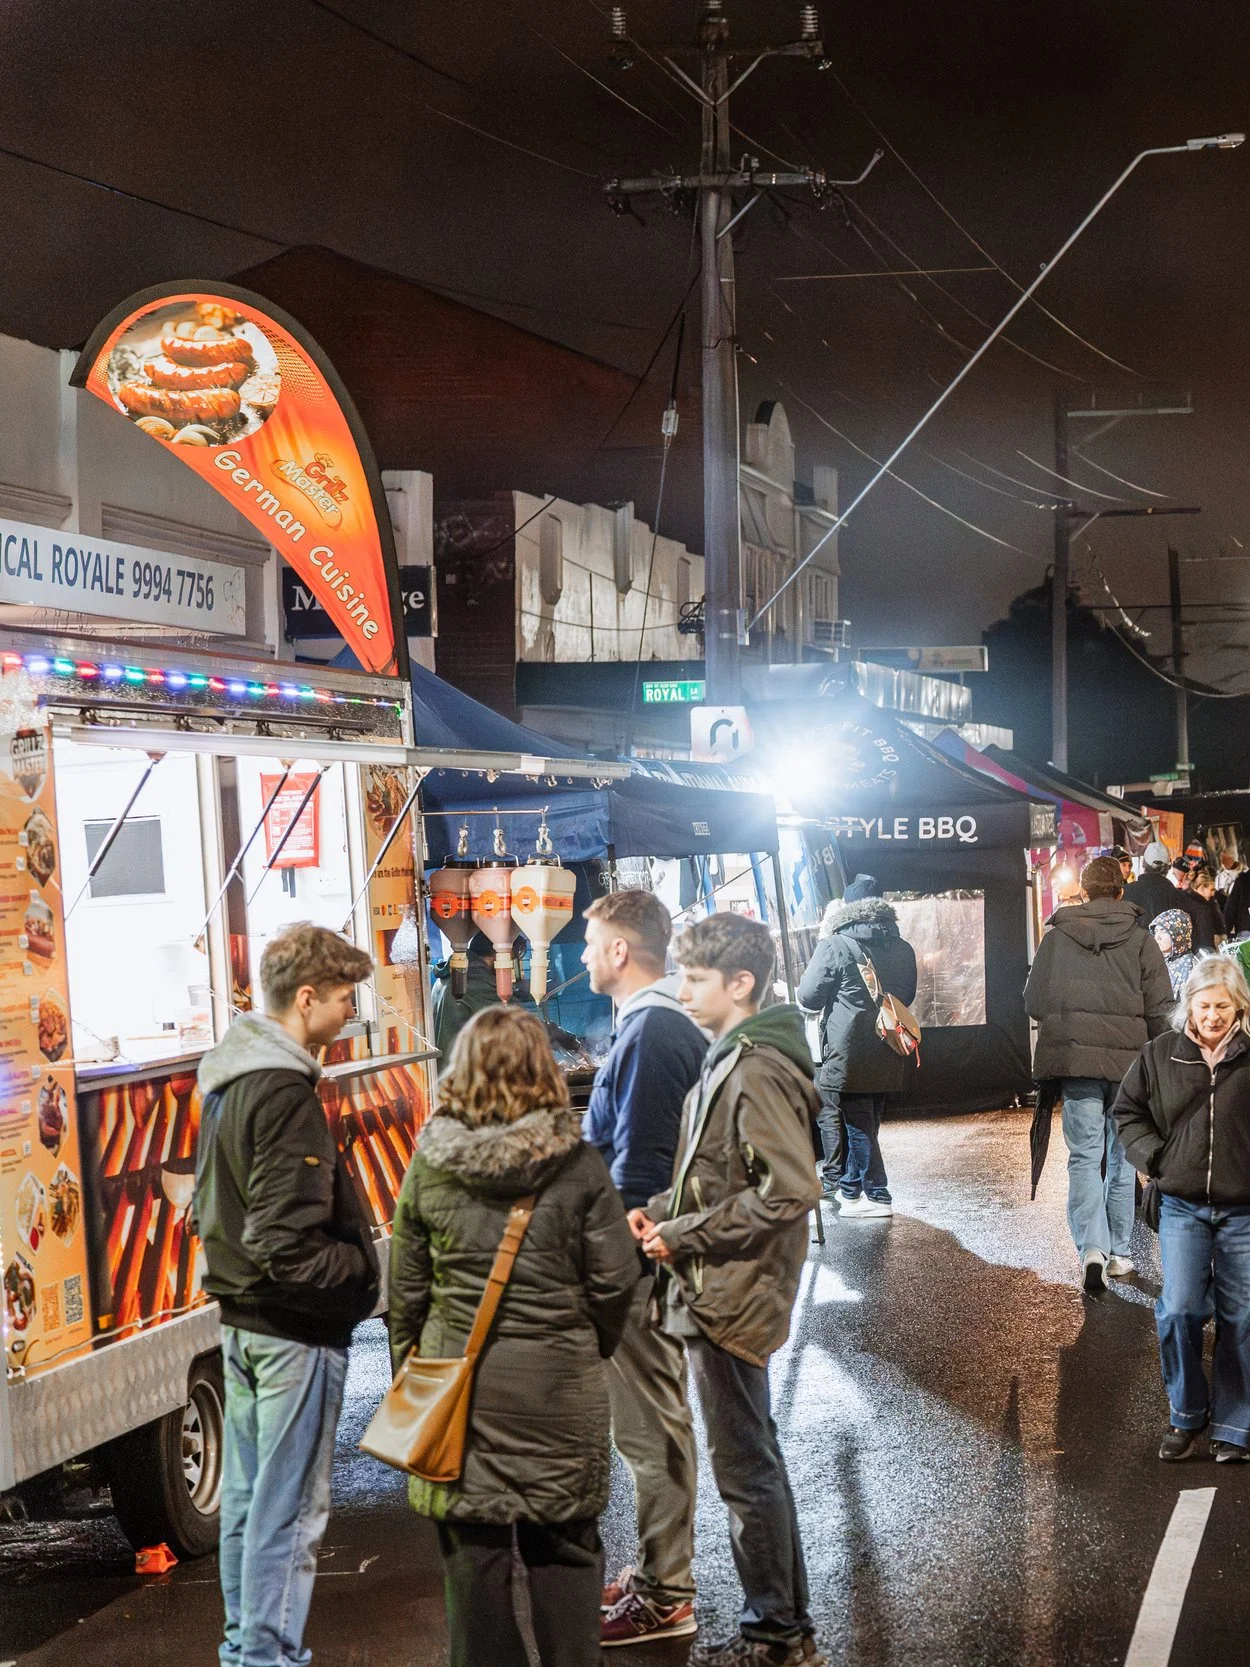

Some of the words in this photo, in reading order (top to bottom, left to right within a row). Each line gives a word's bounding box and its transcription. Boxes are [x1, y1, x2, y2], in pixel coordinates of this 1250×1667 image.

[279, 460, 340, 515] Master
[214, 450, 306, 542] German
[309, 546, 379, 640] Cuisine
[51, 543, 125, 596] ROYALE
[132, 560, 172, 604] 9994
[176, 568, 215, 611] 7756
[646, 687, 686, 702] ROYAL
[873, 738, 899, 763] BBQ
[918, 815, 978, 843] BBQ
